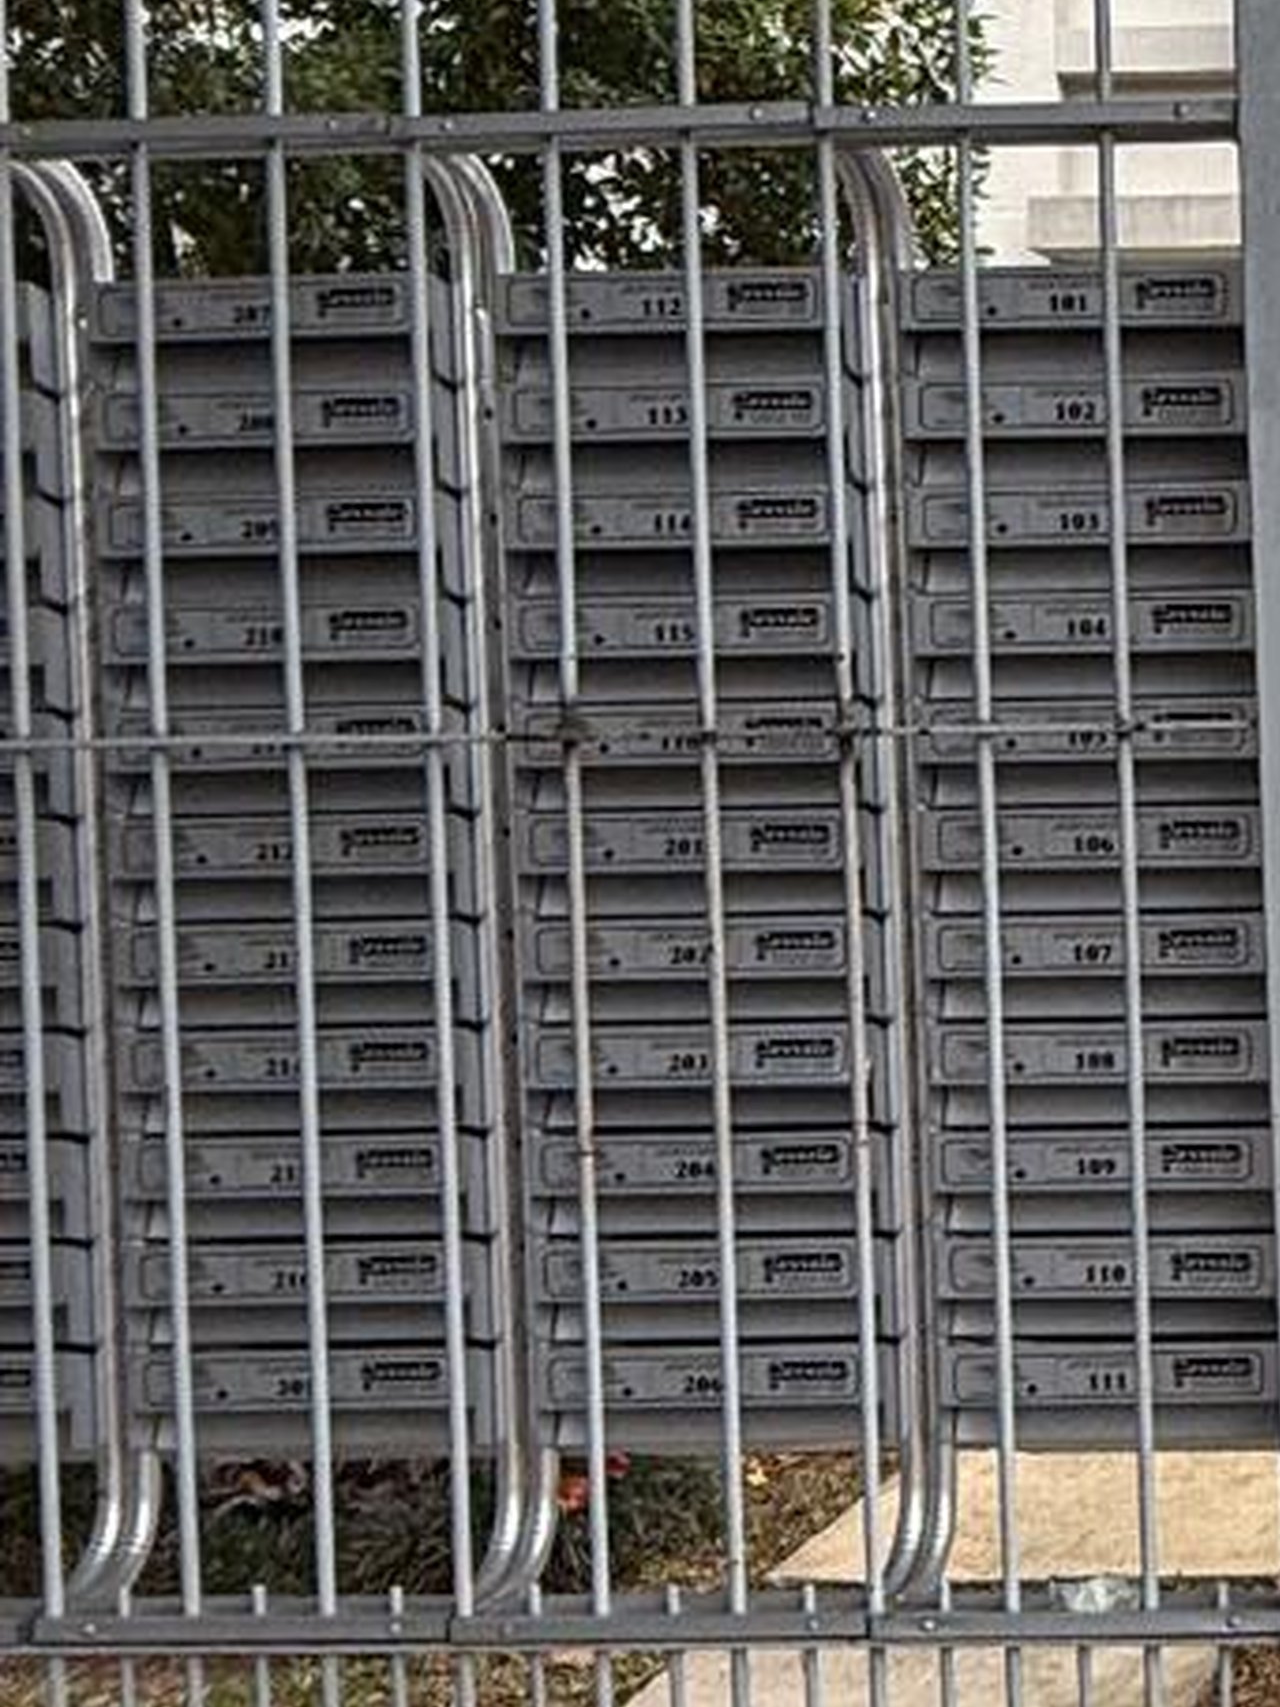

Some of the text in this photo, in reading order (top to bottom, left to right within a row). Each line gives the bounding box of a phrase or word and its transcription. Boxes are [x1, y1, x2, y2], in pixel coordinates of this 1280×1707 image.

[643, 297, 682, 315] 112
[1050, 295, 1087, 312] 101
[649, 407, 687, 424] 113
[1055, 402, 1096, 420] 102
[1075, 835, 1114, 853] 106
[1074, 945, 1111, 962] 107
[1086, 1265, 1125, 1282] 110
[1090, 1373, 1127, 1390] 111
